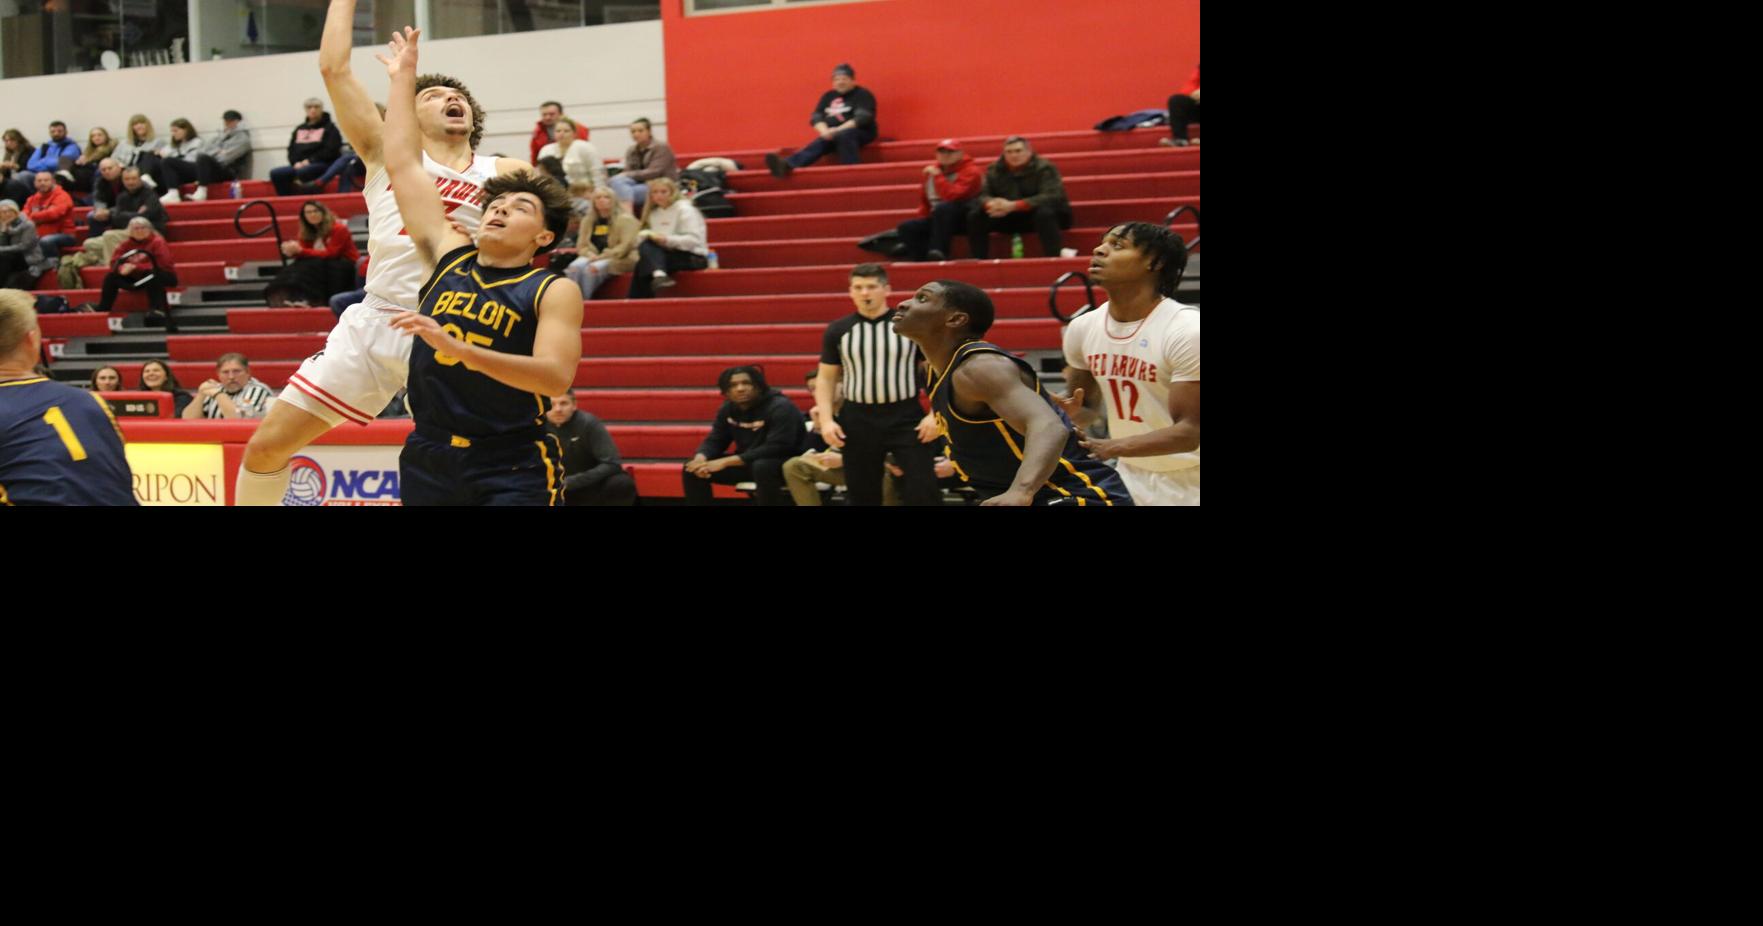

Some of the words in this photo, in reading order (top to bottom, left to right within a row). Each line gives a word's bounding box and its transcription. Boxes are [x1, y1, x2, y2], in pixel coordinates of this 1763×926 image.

[431, 290, 522, 338] BELOIT
[1107, 378, 1144, 423] 12
[42, 406, 88, 462] 1
[132, 473, 217, 504] RIPON
